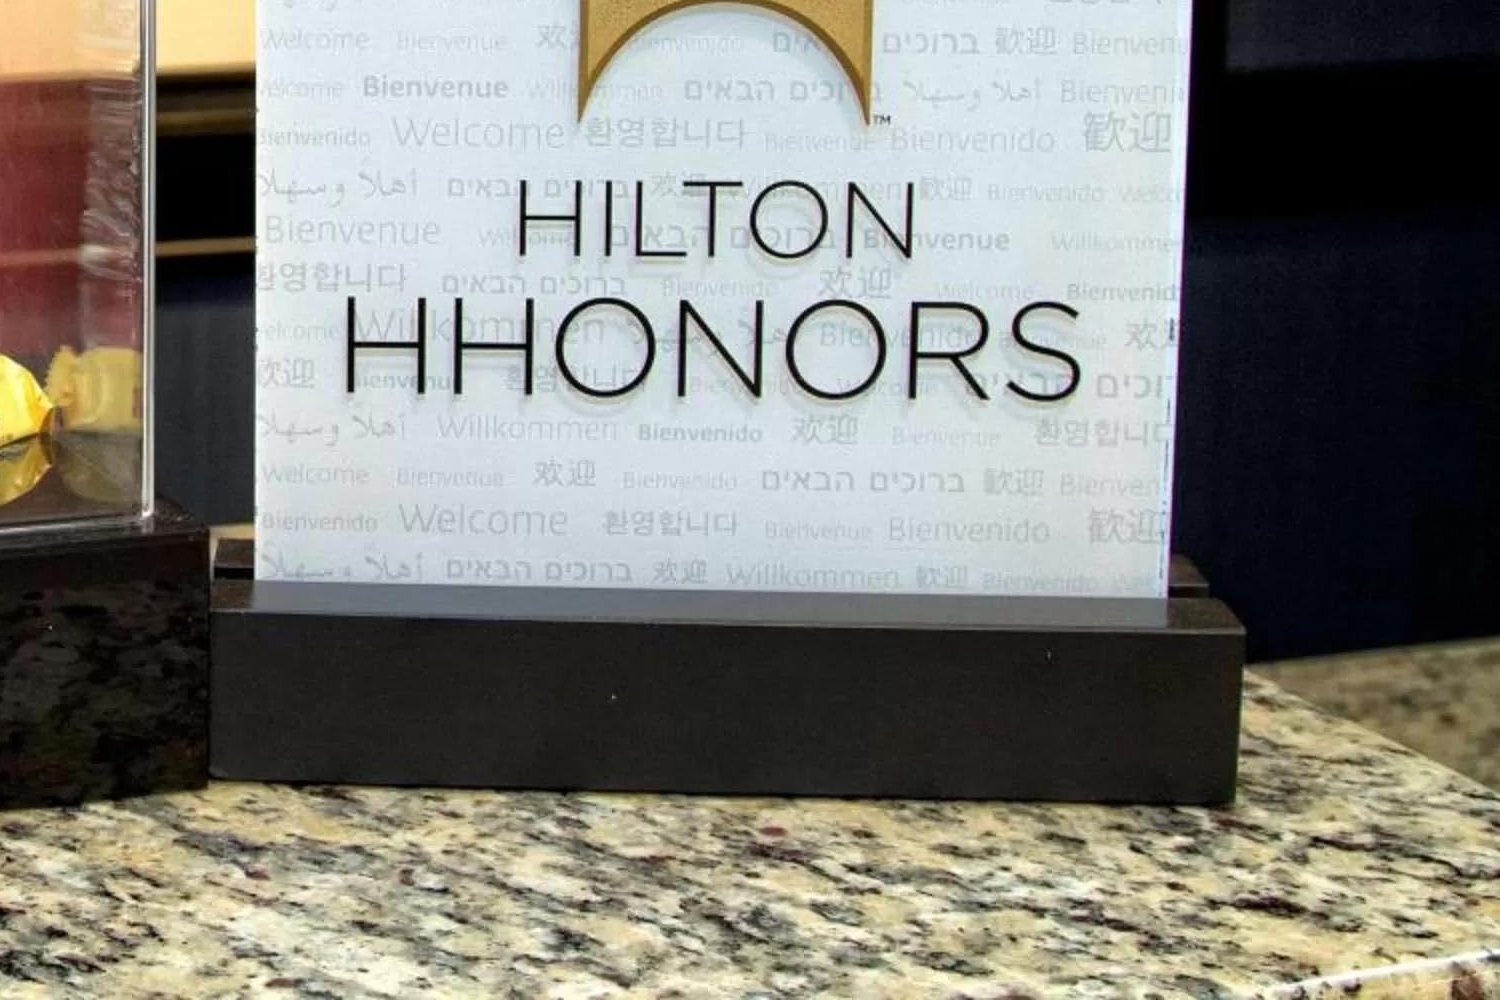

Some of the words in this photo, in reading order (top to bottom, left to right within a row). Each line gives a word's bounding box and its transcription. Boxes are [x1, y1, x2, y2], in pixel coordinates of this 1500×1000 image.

[883, 31, 980, 54] ברוכים
[363, 75, 509, 99] Bienvenue
[685, 79, 774, 102] הבאים
[392, 115, 565, 149] Welcome
[585, 116, 745, 149] 환영합니다
[890, 127, 1056, 153] Bienvenido
[265, 216, 441, 246] Bienvenue
[518, 178, 915, 261] HILTON
[442, 273, 527, 295] הבאים
[540, 273, 626, 296] ברוכים
[818, 266, 892, 299] 欢迎
[1066, 282, 1178, 301] Bienvenid
[346, 294, 1081, 402] HHONORS
[437, 412, 617, 442] Willkommen
[638, 424, 763, 442] Bienvenido
[790, 415, 859, 445] 欢迎
[262, 464, 370, 485] Welcome
[533, 458, 597, 488] 欢迎
[761, 469, 855, 492] הבאים
[870, 469, 965, 493] ברוכים
[263, 512, 378, 533] Bienvenido
[398, 503, 568, 536] Welcome
[602, 510, 737, 536] 환영합니다
[888, 515, 1051, 544] Bienvenido
[445, 558, 531, 580] הבאים
[545, 558, 632, 582] ברוכים
